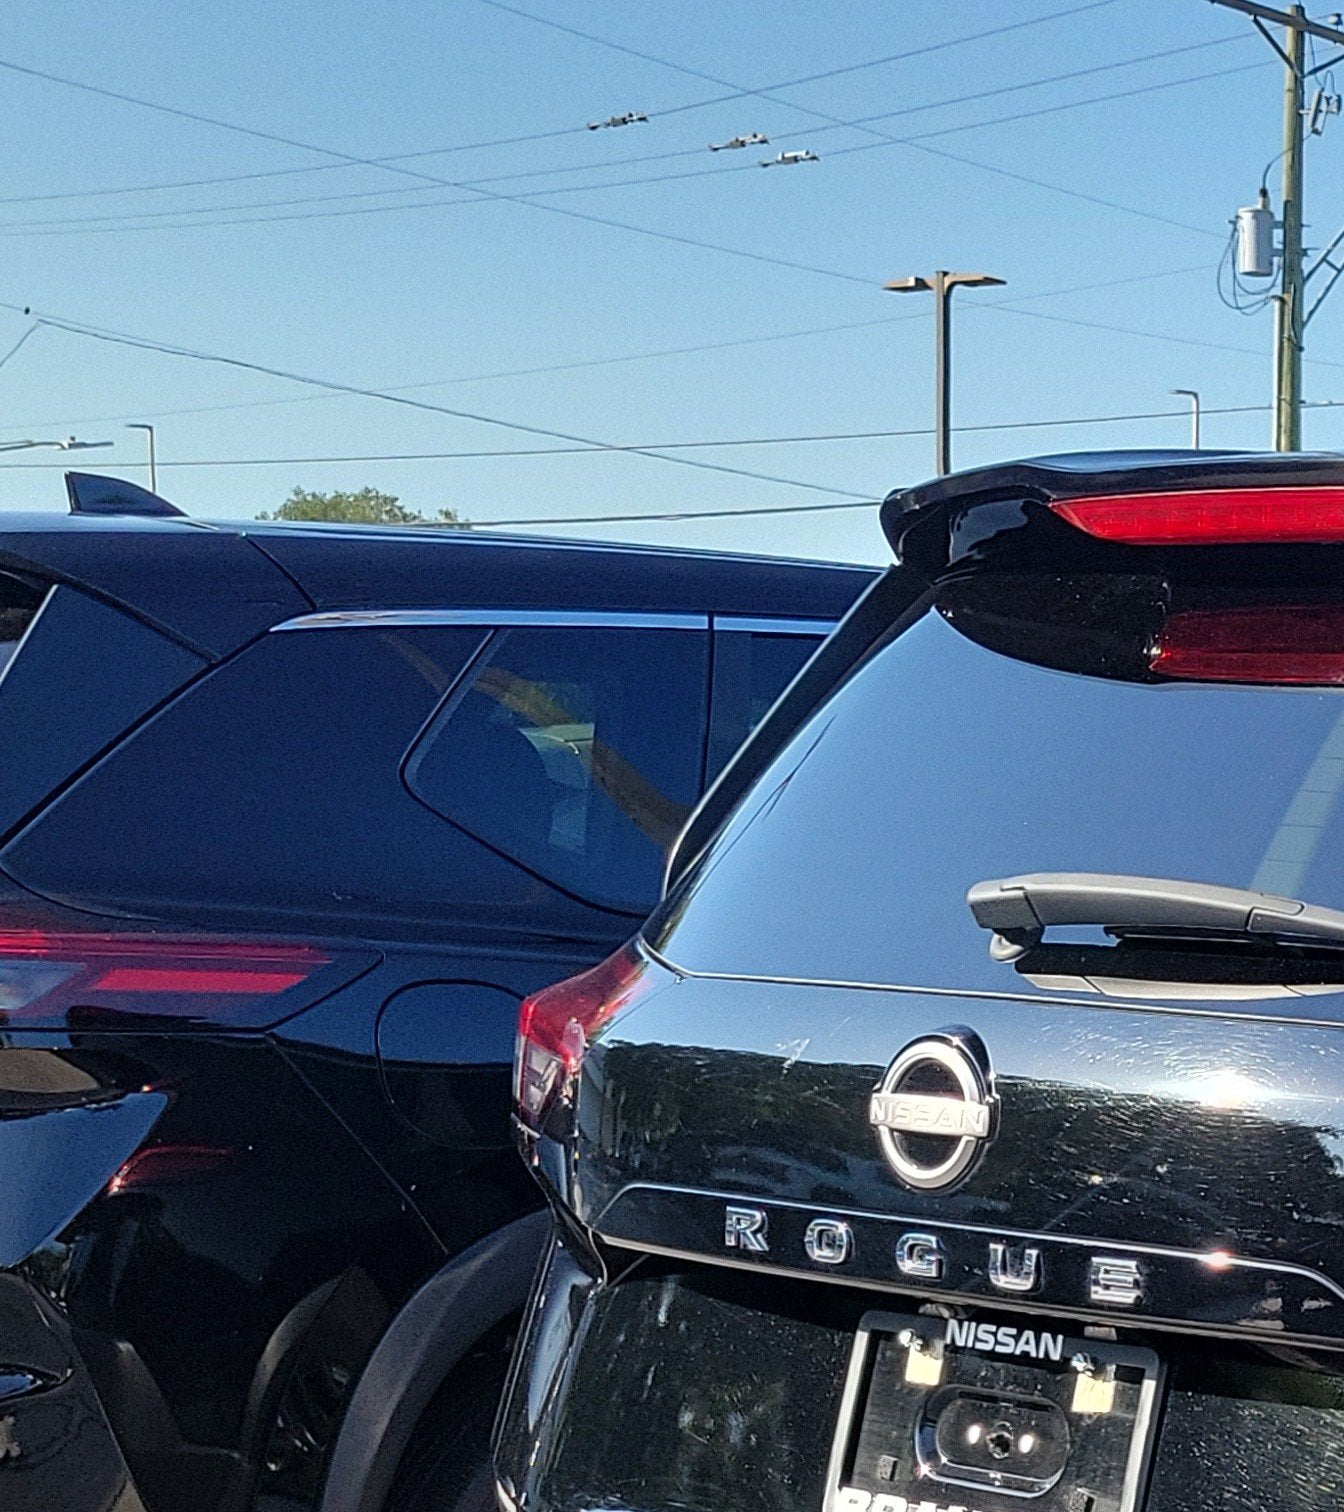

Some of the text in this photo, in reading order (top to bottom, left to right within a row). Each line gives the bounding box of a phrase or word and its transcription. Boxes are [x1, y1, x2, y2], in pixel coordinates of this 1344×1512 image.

[870, 1096, 986, 1135] NISSAN
[725, 1206, 1147, 1306] ROGUE
[944, 1318, 1064, 1361] NISSAN
